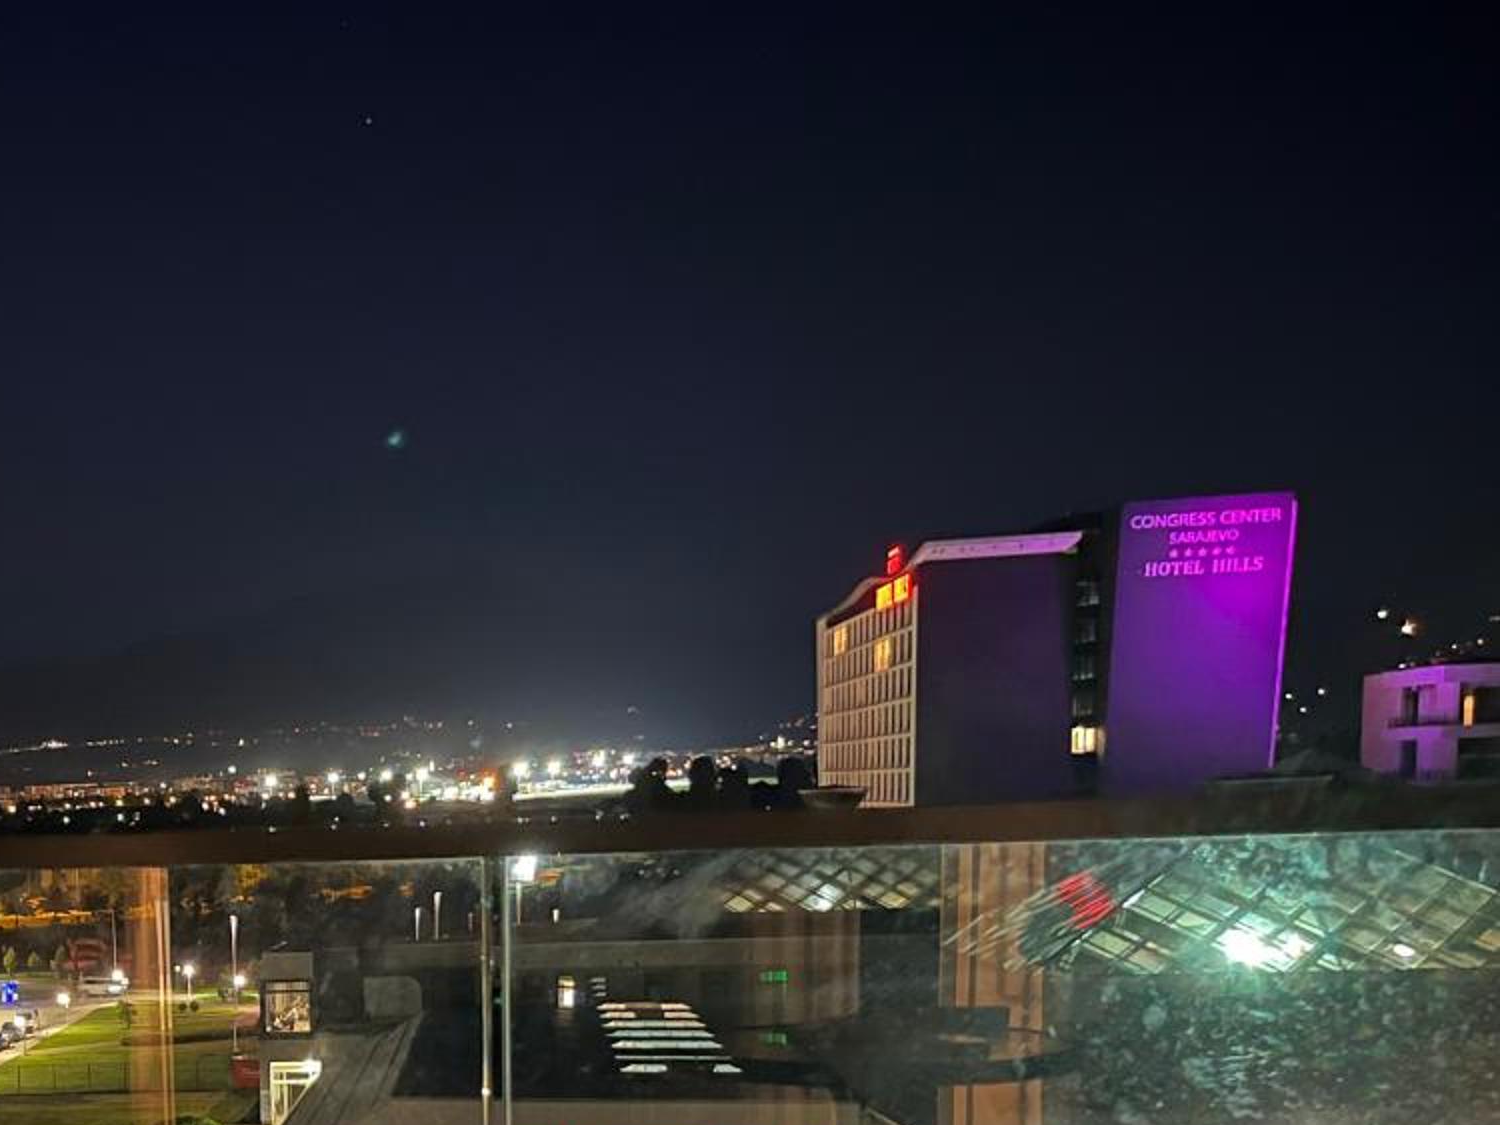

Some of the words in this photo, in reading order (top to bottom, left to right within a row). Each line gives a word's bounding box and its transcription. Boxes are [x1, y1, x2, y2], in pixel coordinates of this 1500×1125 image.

[1130, 511, 1216, 529] CONGRESS
[1219, 507, 1282, 524] CENTER
[1169, 528, 1239, 545] SARAJEVO
[1143, 560, 1204, 577] HOTEL
[1212, 556, 1264, 573] HILLS
